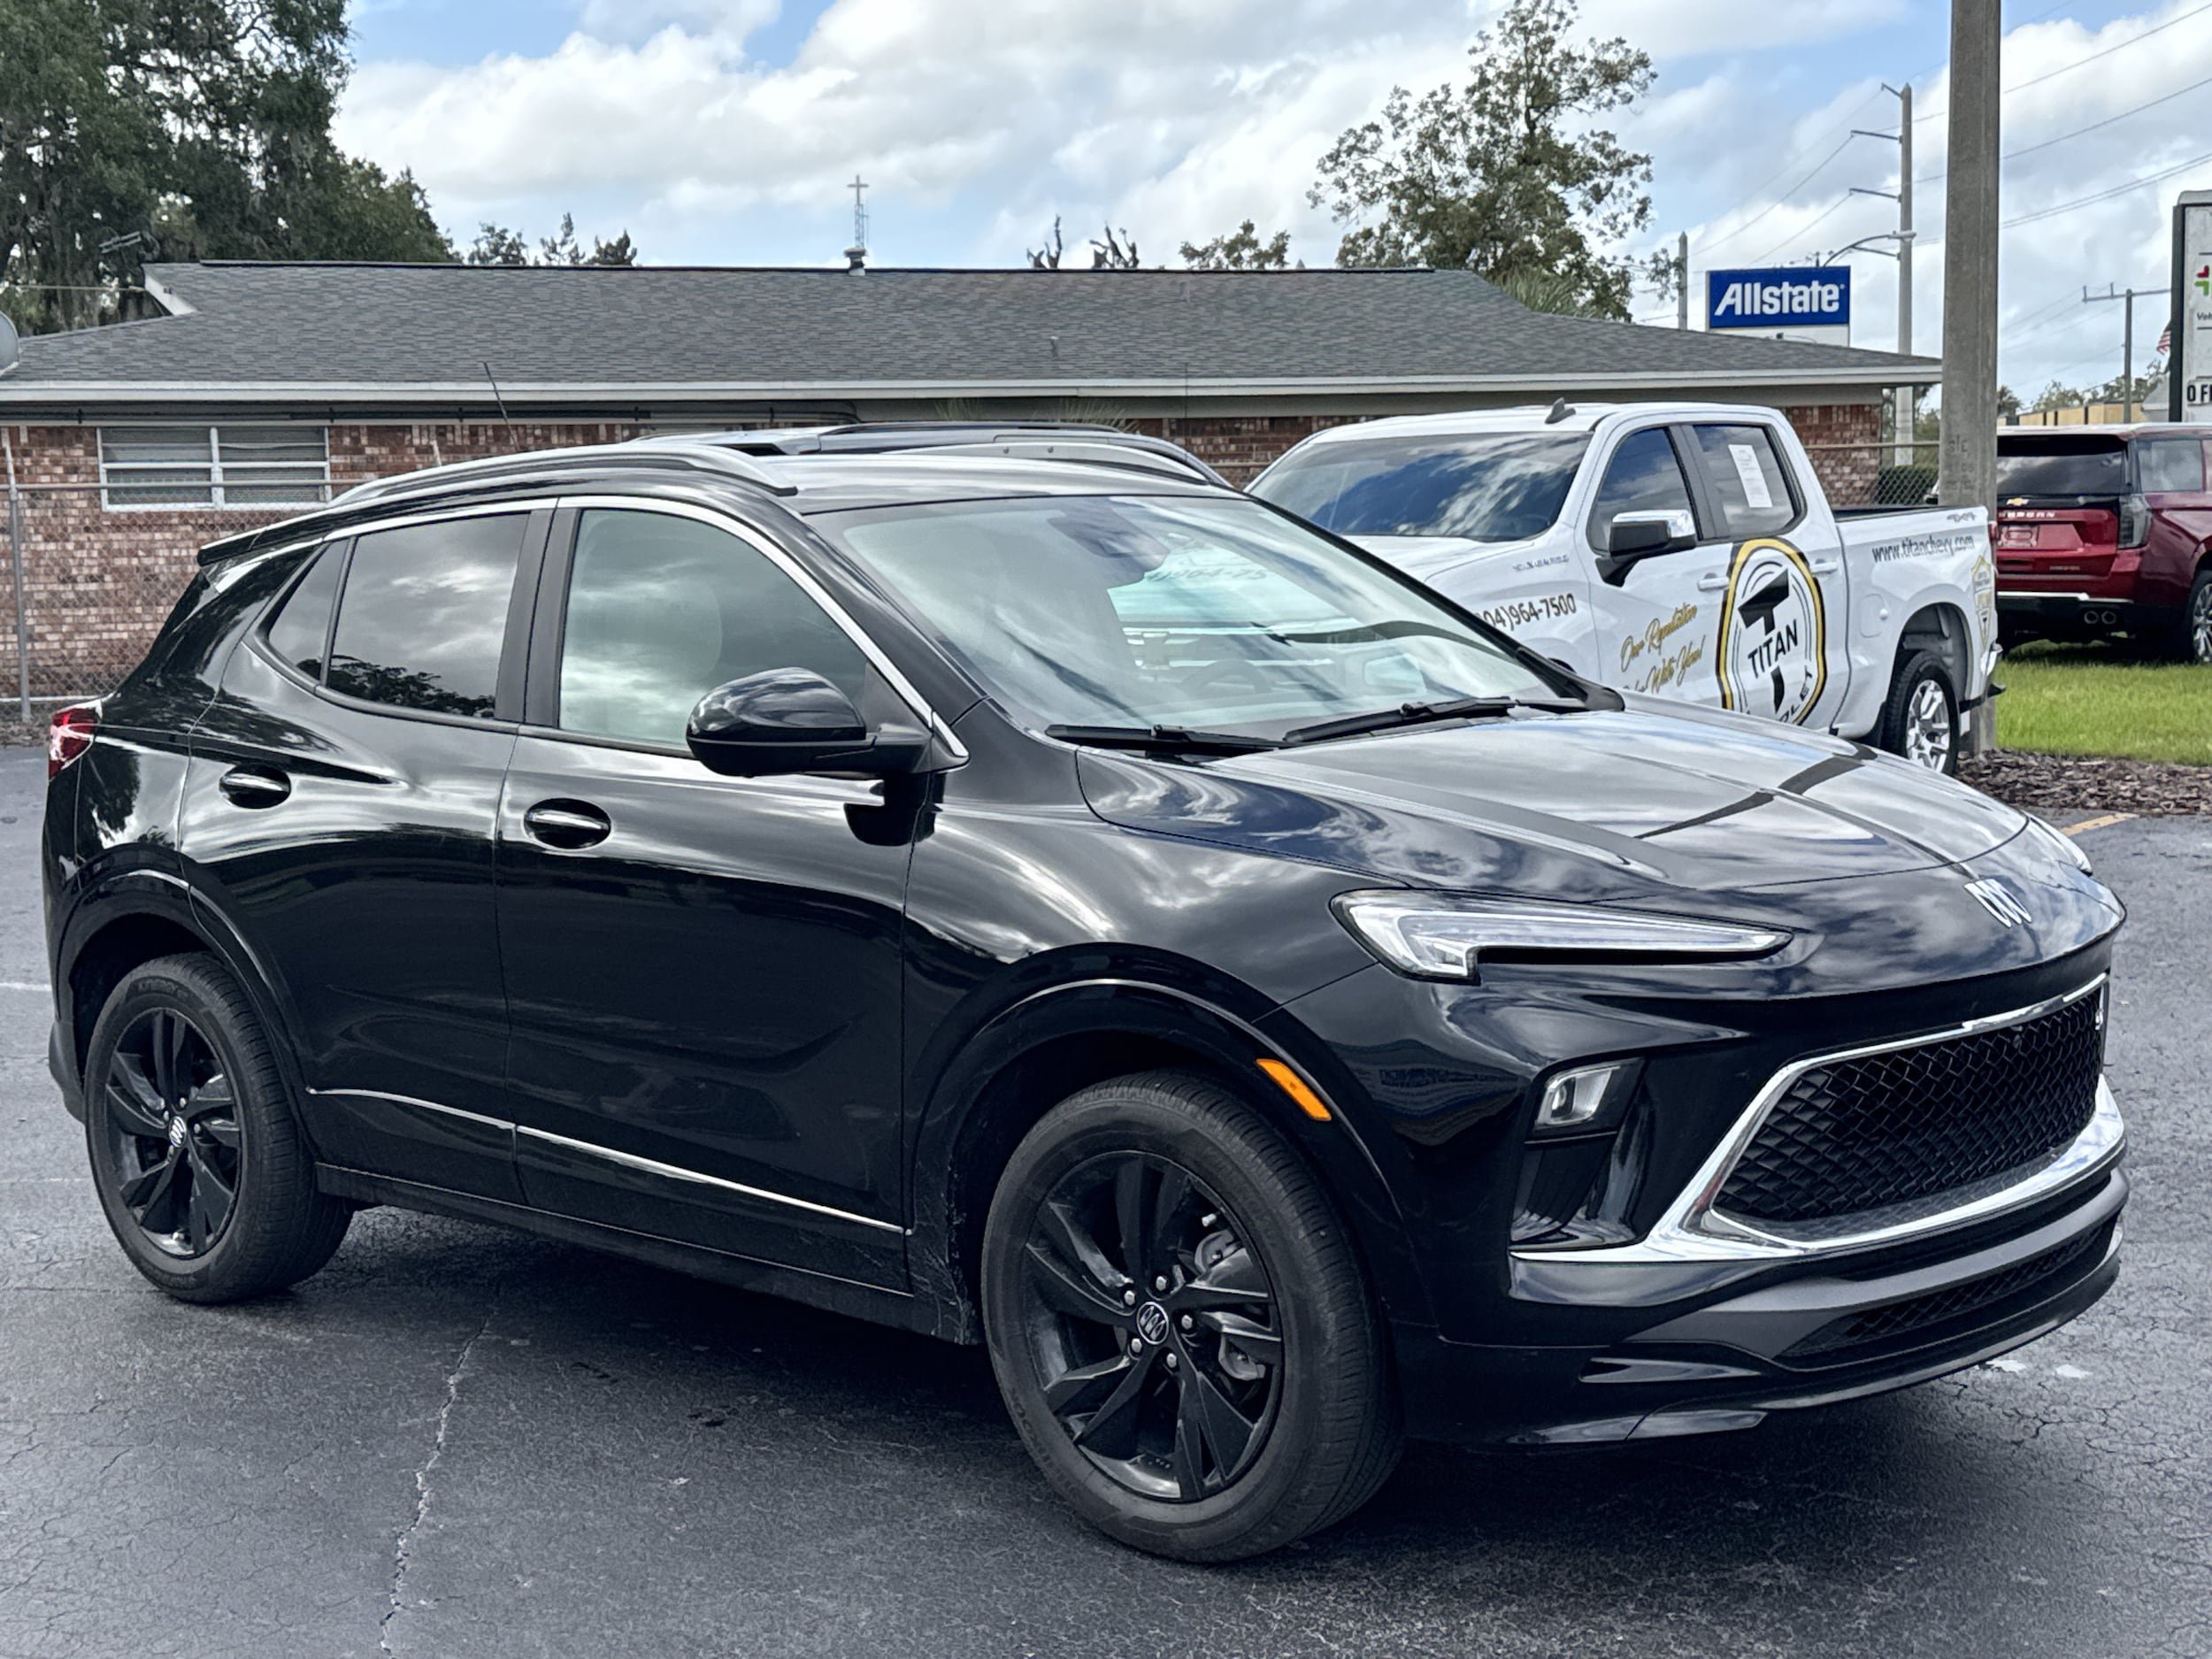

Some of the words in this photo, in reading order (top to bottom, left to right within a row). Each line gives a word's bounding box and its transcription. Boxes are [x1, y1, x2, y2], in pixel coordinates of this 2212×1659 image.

[1714, 280, 1840, 316] Allstate
[1871, 534, 1975, 564] www.titanchevy.com
[1474, 592, 1577, 632] 04)964-7500
[1620, 635, 1645, 672] Our
[1646, 603, 1697, 656] Reputation
[1747, 619, 1799, 679] TITAN
